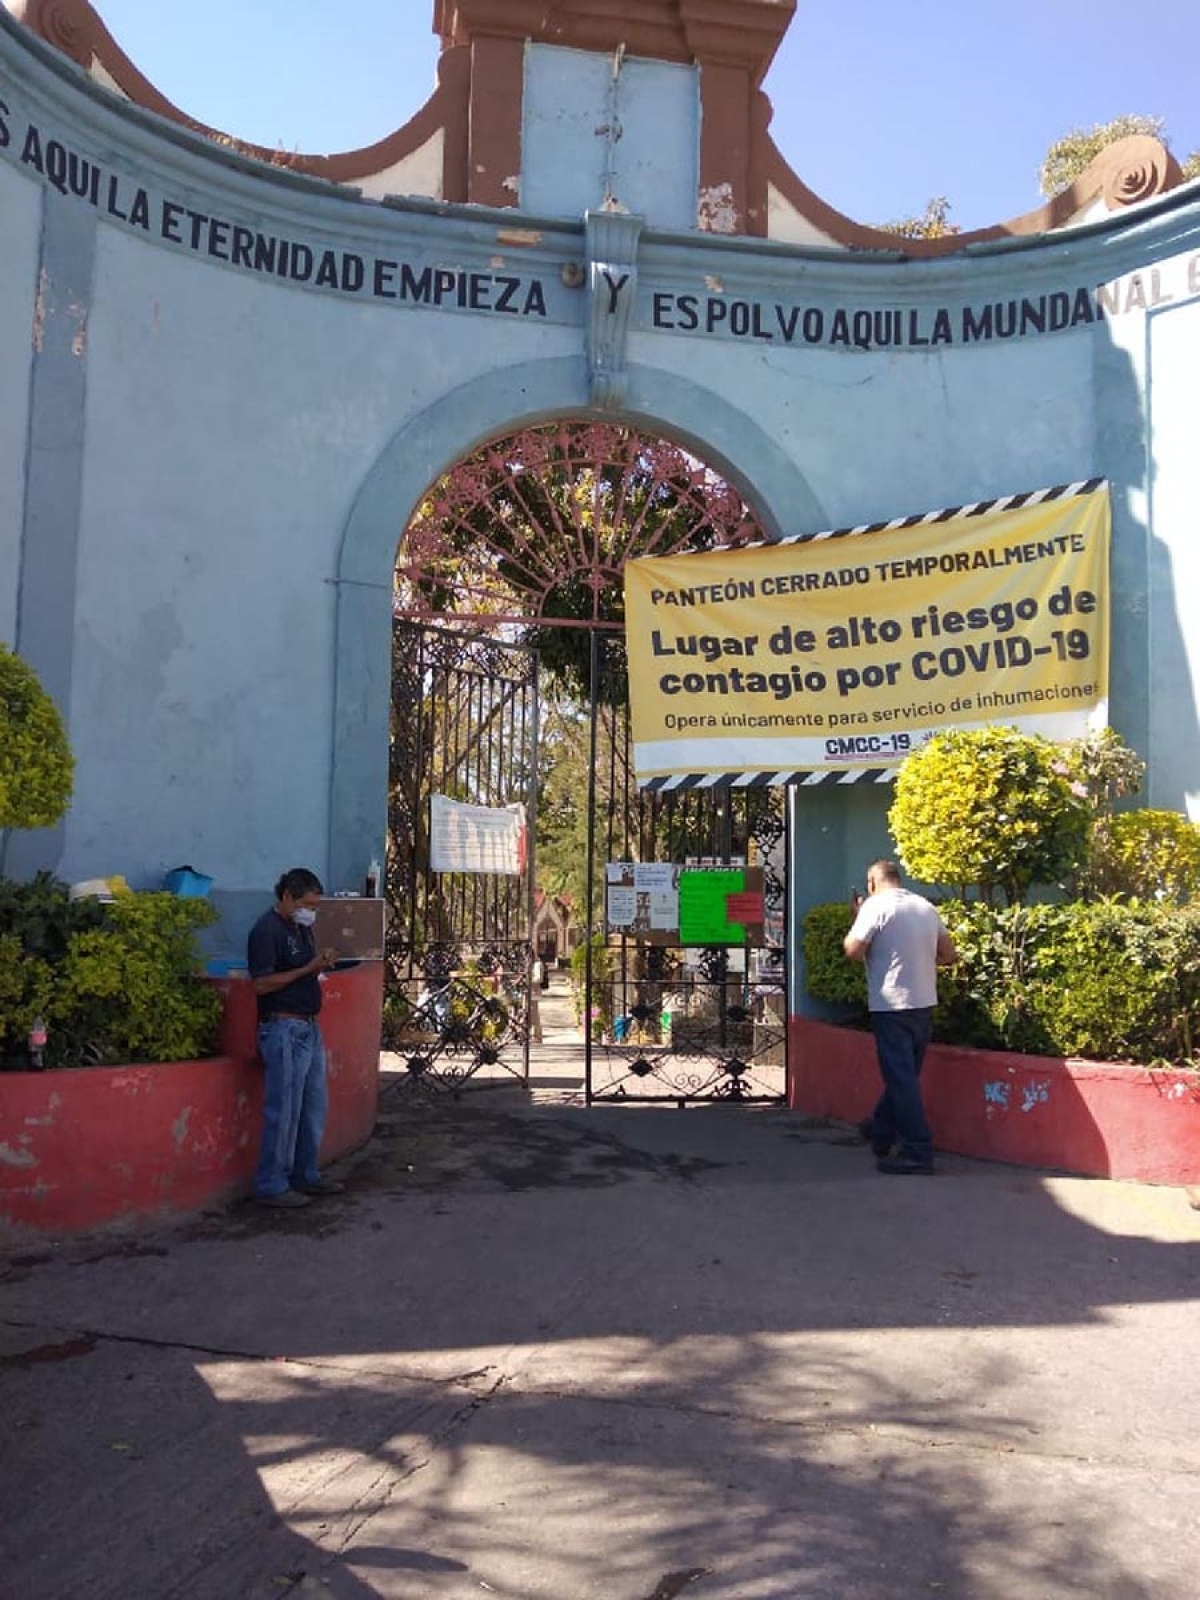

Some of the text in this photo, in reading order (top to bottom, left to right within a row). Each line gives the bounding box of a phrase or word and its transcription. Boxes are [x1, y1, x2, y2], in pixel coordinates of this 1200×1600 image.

[20, 123, 100, 206] AQUI
[108, 175, 150, 231] LA
[161, 200, 365, 293] ETERNIDAD
[373, 259, 547, 316] EMPIEZA
[602, 271, 629, 313] Y
[653, 292, 698, 330] ES
[706, 298, 824, 343] POLVO
[829, 308, 902, 350] AQUI
[908, 308, 952, 345] LA
[962, 267, 1172, 343] MUNDANAL
[651, 534, 1086, 607] PANTEÓN CERRADO TEMPORALMENTE
[651, 586, 1096, 661] Lugar de alto riesgo de
[659, 629, 1090, 700] contagio por COVID-19
[665, 714, 717, 731] Opera
[722, 712, 824, 728] únicamente
[829, 711, 868, 728] para
[873, 700, 946, 722] servicio
[951, 697, 972, 712] de
[825, 734, 911, 754] CMCC-19
